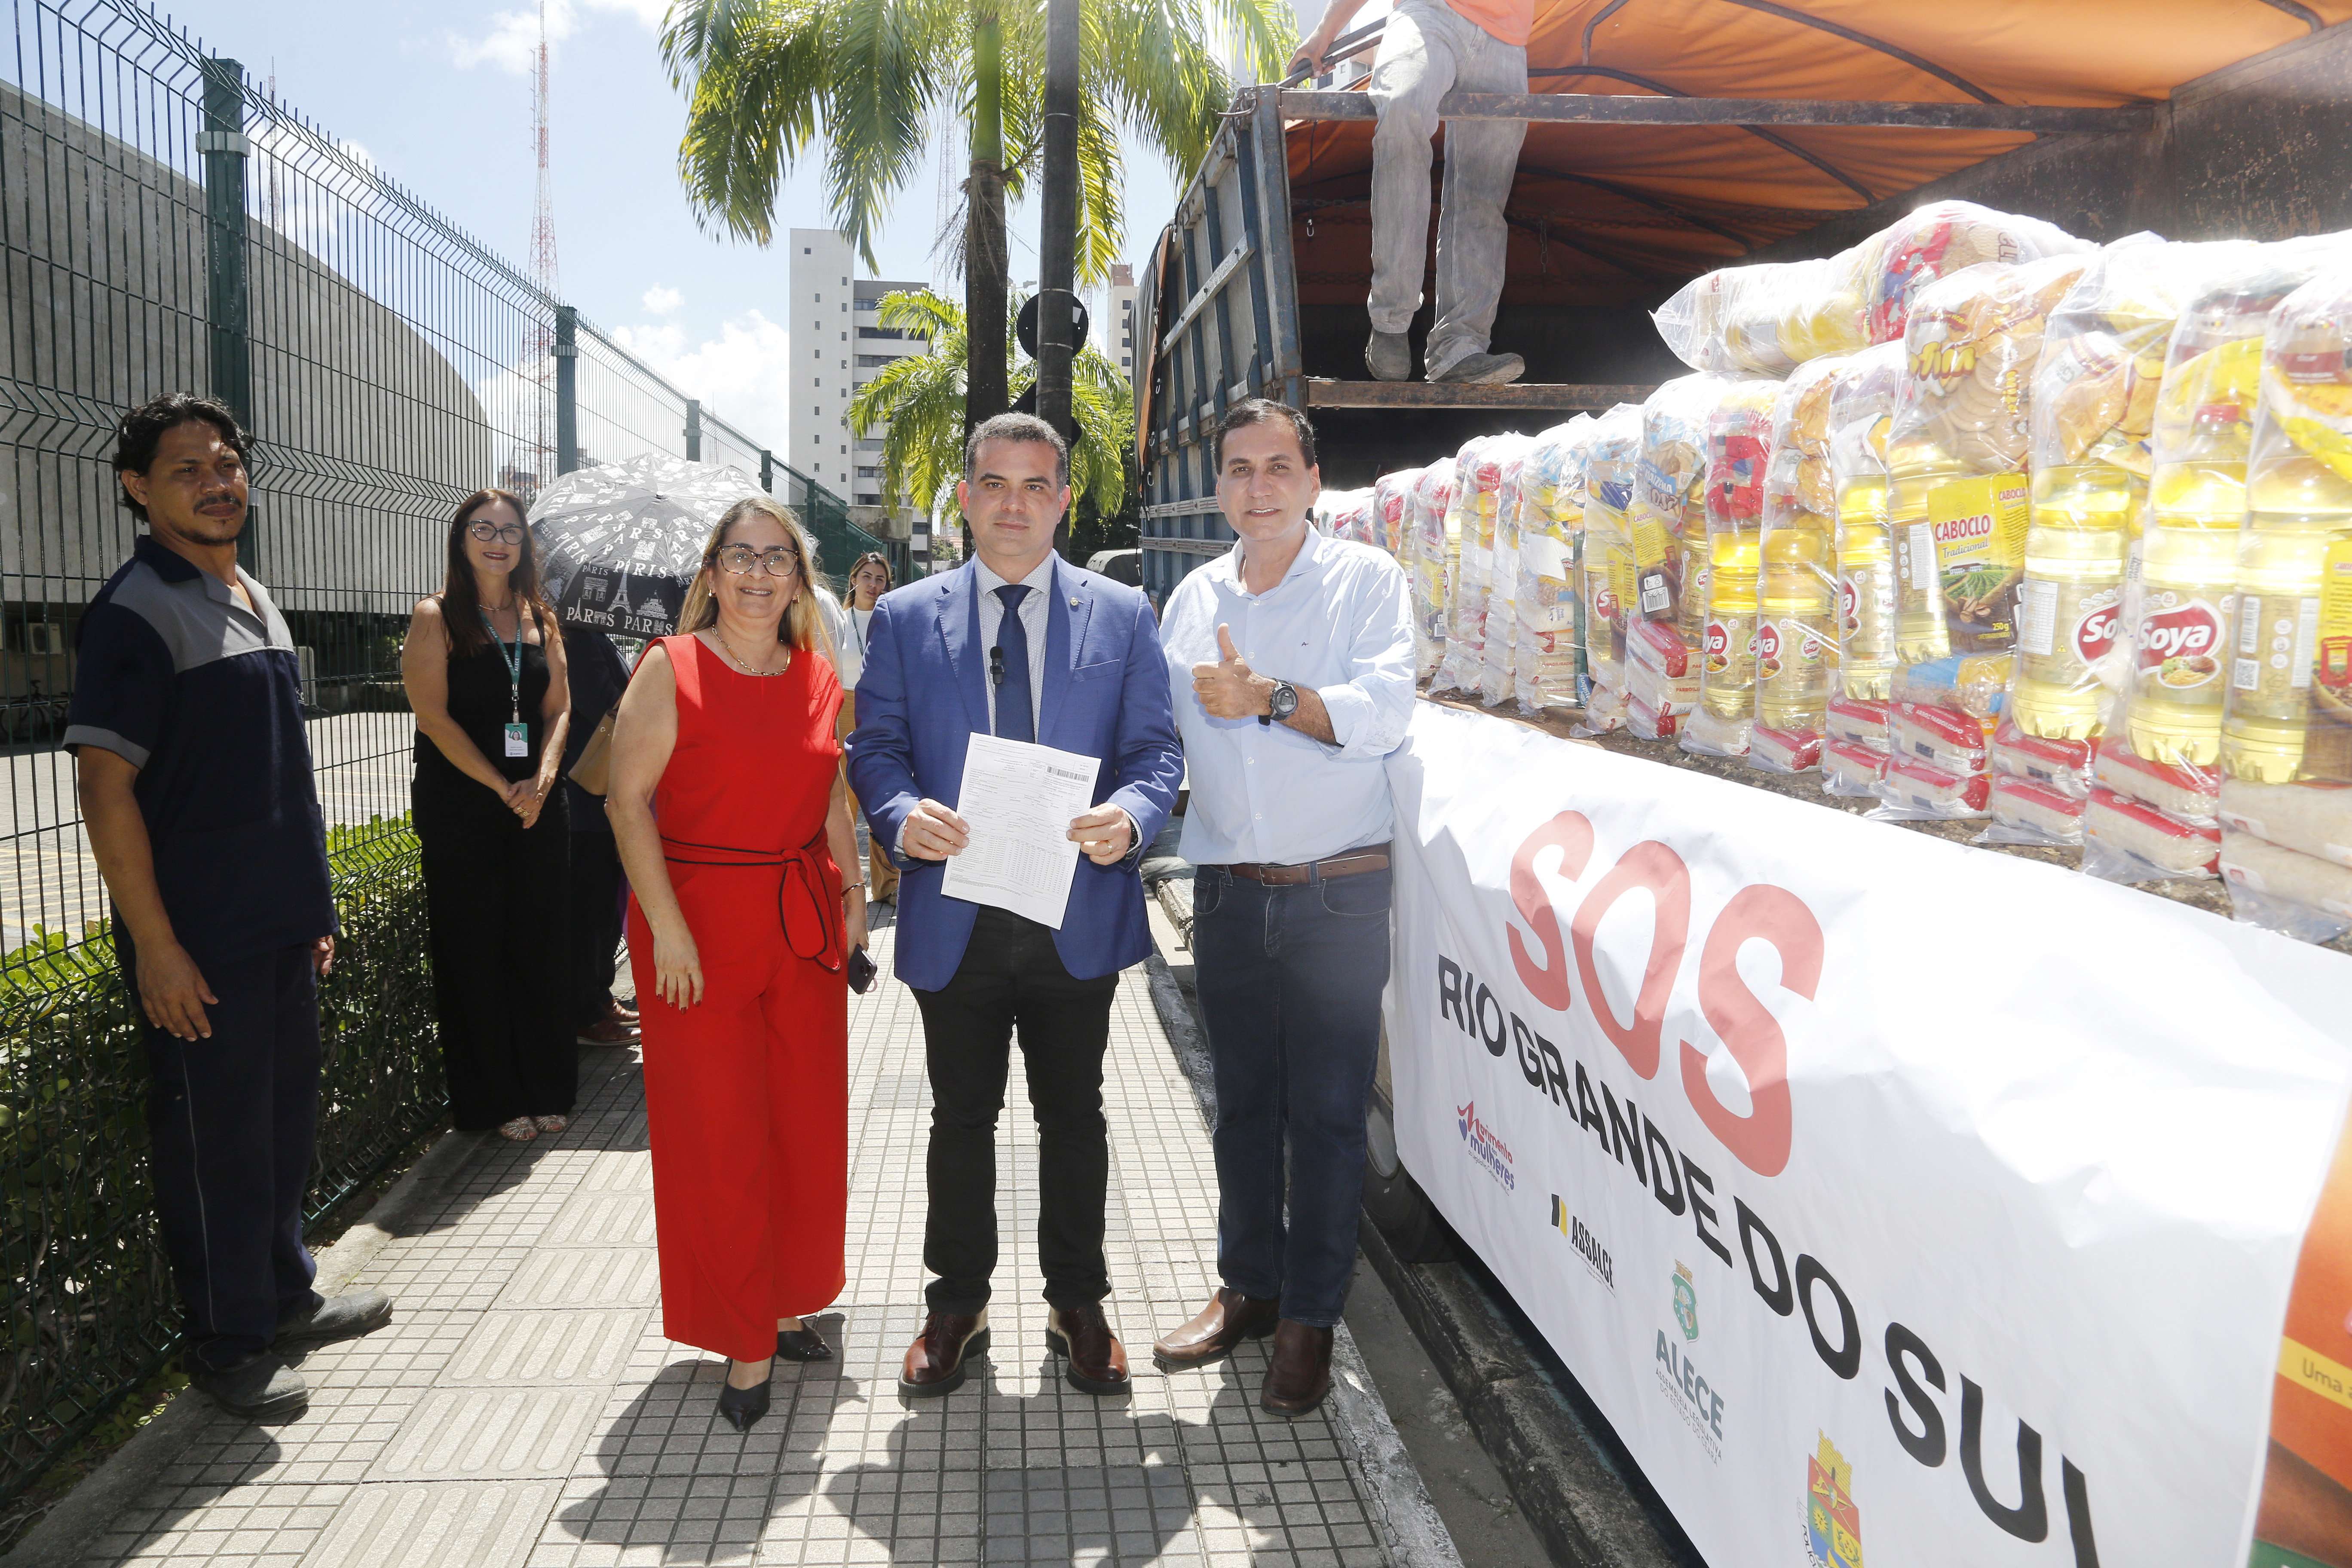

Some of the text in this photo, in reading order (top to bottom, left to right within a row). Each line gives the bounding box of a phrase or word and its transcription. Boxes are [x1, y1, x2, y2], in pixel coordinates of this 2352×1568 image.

[1633, 512, 1656, 523] CABOCL
[1935, 514, 1991, 542] CABOCLO
[1942, 537, 1990, 559] Tradicional
[582, 561, 609, 576] PARIS
[676, 574, 695, 588] PARI
[566, 597, 615, 627] PARIS
[623, 615, 673, 637] PARIS
[2082, 615, 2119, 643] So
[2138, 622, 2211, 657] Soya
[1506, 809, 1825, 1178] SOS
[1457, 1101, 1513, 1164] Movimento
[1438, 954, 1507, 1057] RIO
[1510, 1012, 1732, 1268] GRANDE
[1733, 1196, 1861, 1379] DO
[1470, 1133, 1514, 1190] mulheres
[1571, 1215, 1614, 1289] ASSALCE
[1656, 1328, 1724, 1442] ALECE
[2302, 1357, 2344, 1395] Uma
[1656, 1367, 1722, 1461] ASSEMBLEIA LEGISLATIVA
[1660, 1382, 1668, 1398] DO
[1670, 1394, 1690, 1427] ESTADO
[1692, 1422, 1700, 1439] DO
